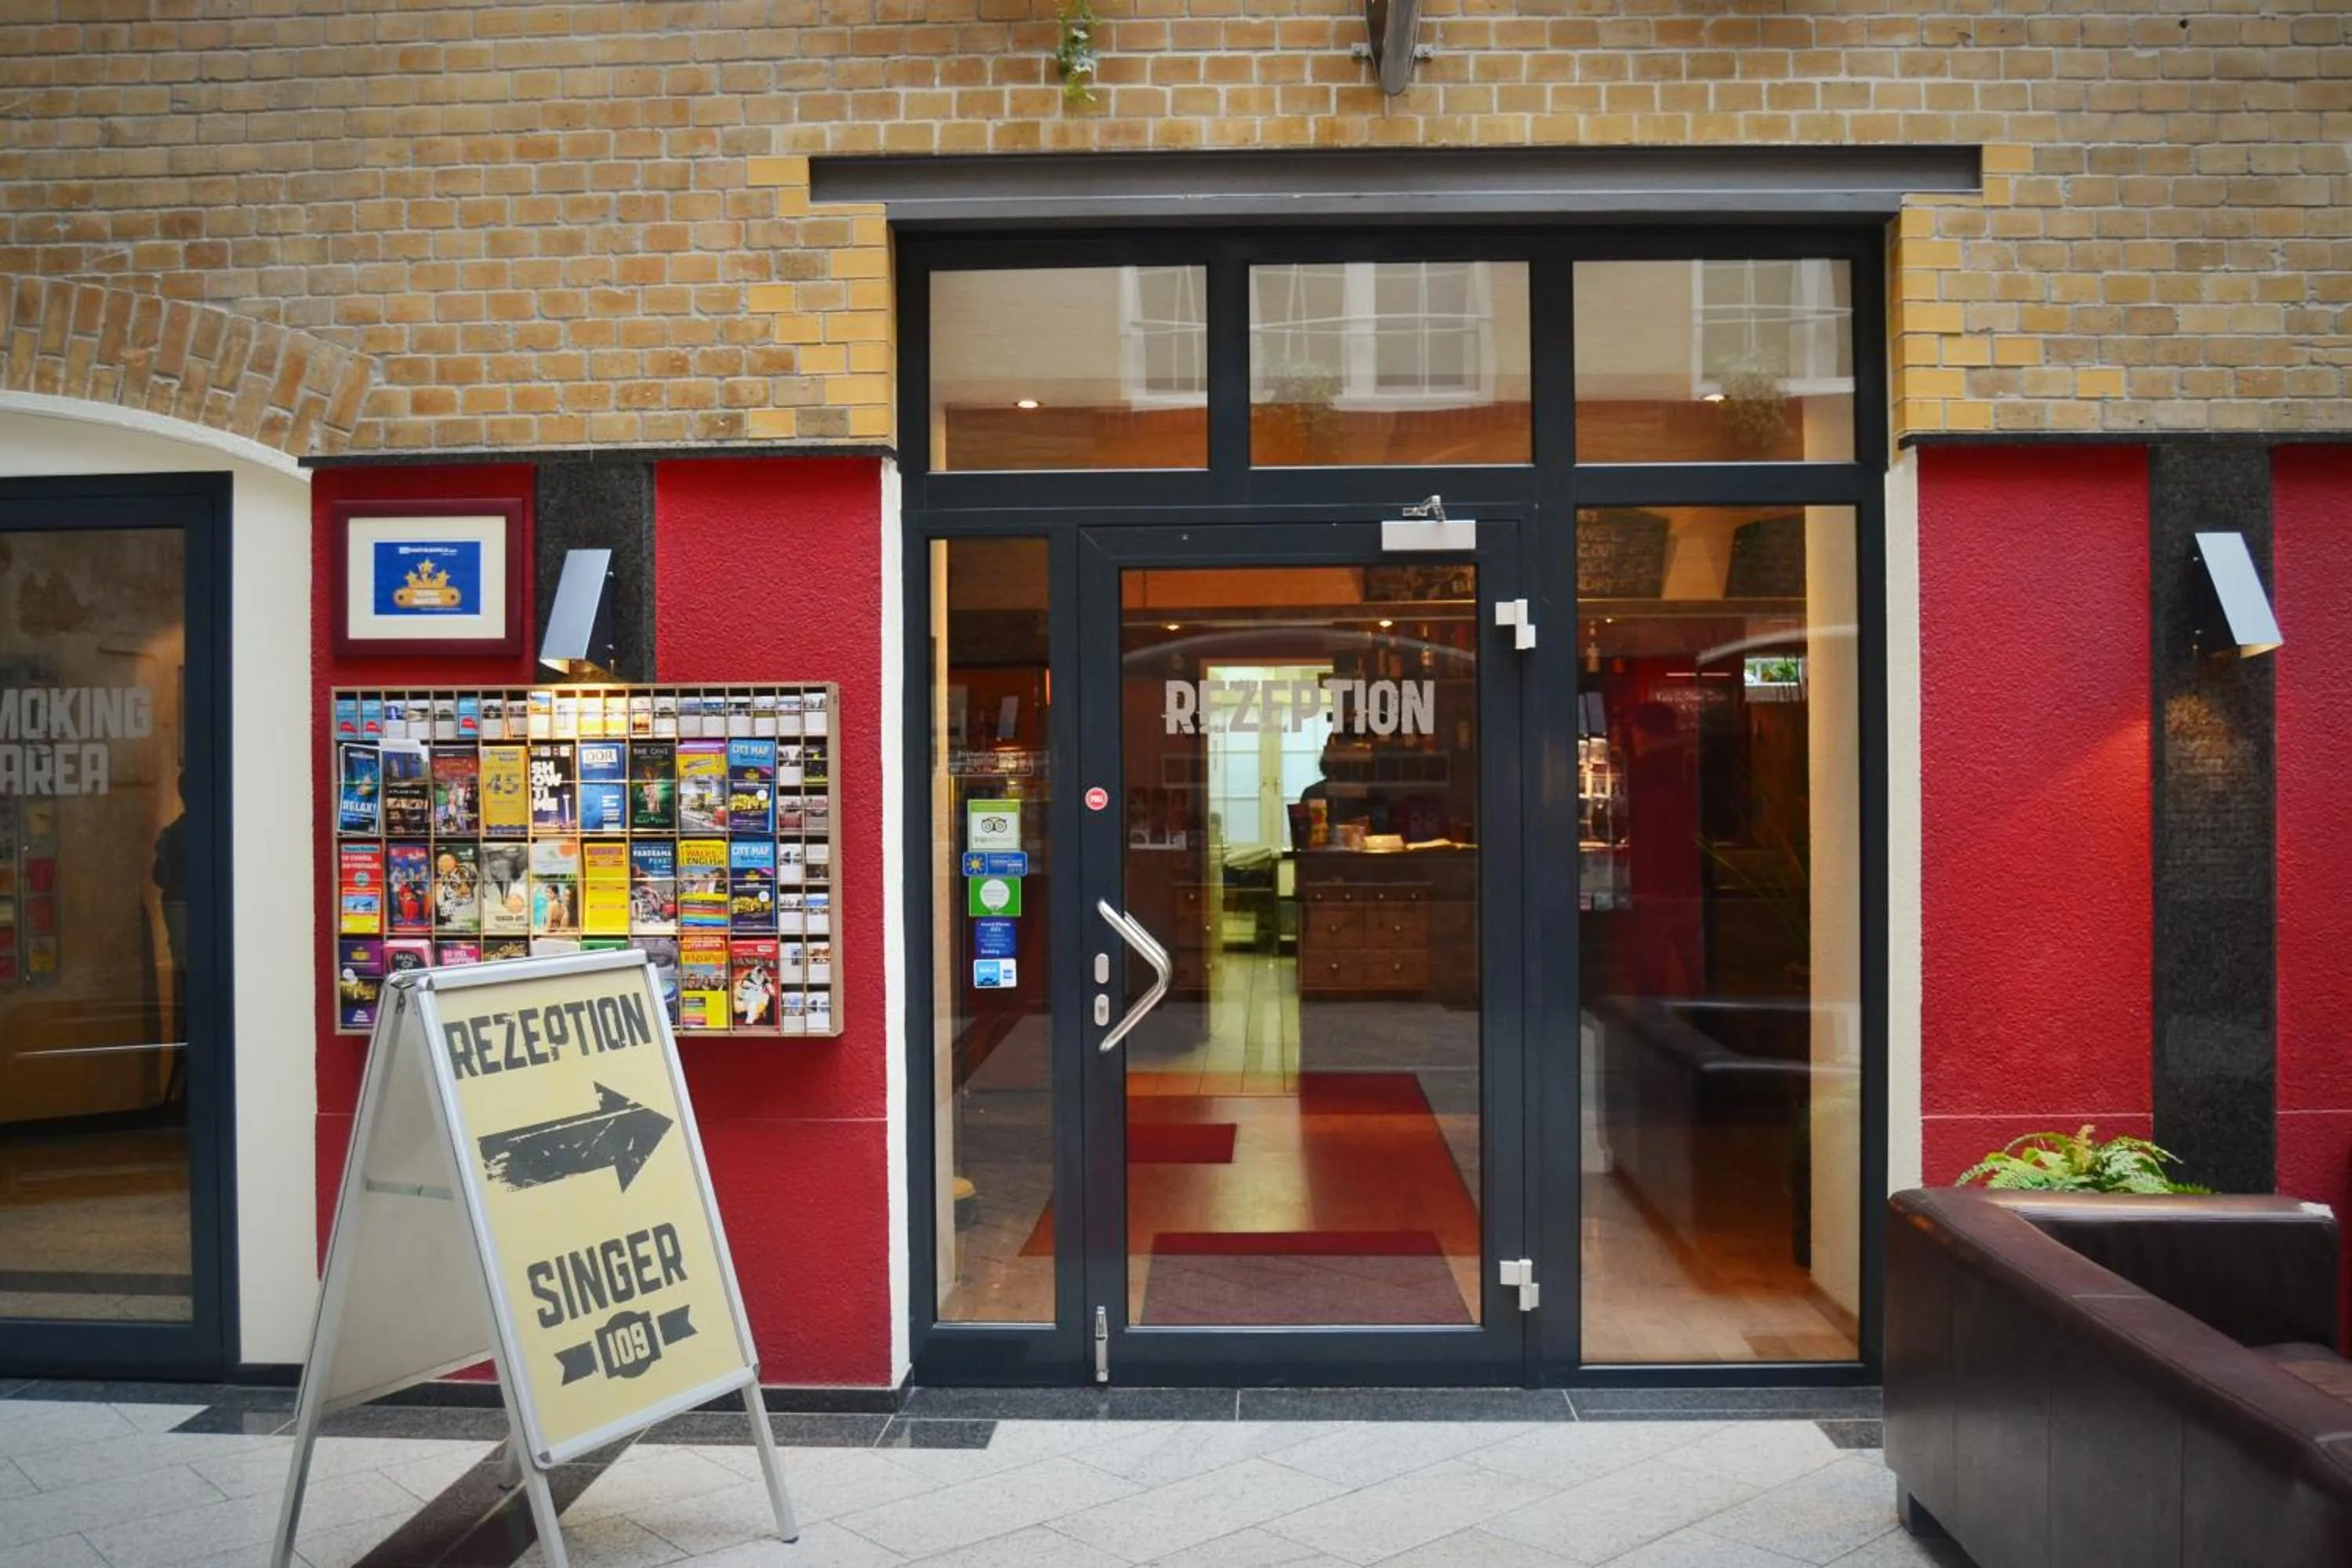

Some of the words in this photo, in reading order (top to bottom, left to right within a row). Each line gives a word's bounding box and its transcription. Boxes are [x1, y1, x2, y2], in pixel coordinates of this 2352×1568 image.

[1164, 680, 1436, 735] REZEPTION
[0, 743, 108, 795] AREA
[442, 992, 652, 1080] REZEPTION
[527, 1222, 688, 1329] SINGER
[607, 1323, 650, 1368] 109
